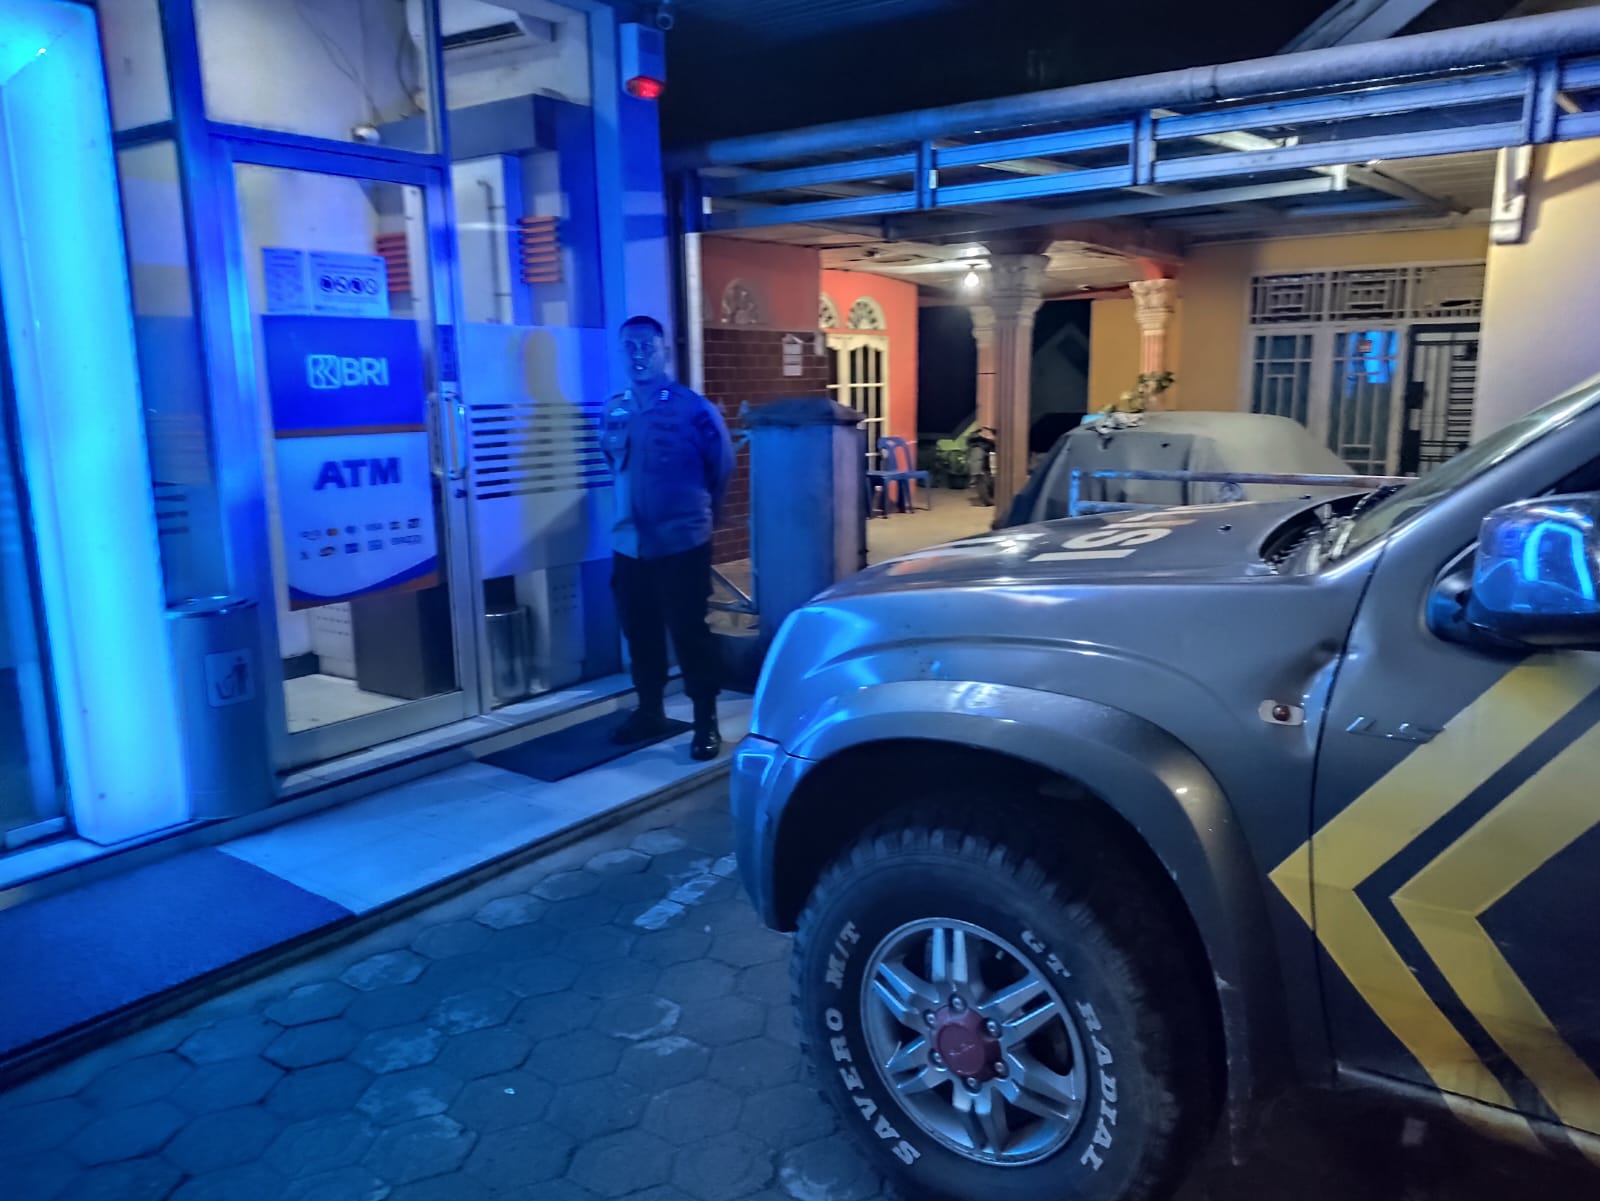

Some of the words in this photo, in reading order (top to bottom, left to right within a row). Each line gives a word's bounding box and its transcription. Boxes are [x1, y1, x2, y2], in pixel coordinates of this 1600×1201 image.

[342, 356, 390, 388] BRI
[314, 457, 402, 491] ATM
[825, 921, 860, 989] M/T
[825, 1007, 921, 1165] SAVERO
[1075, 1001, 1118, 1171] RADIAL
